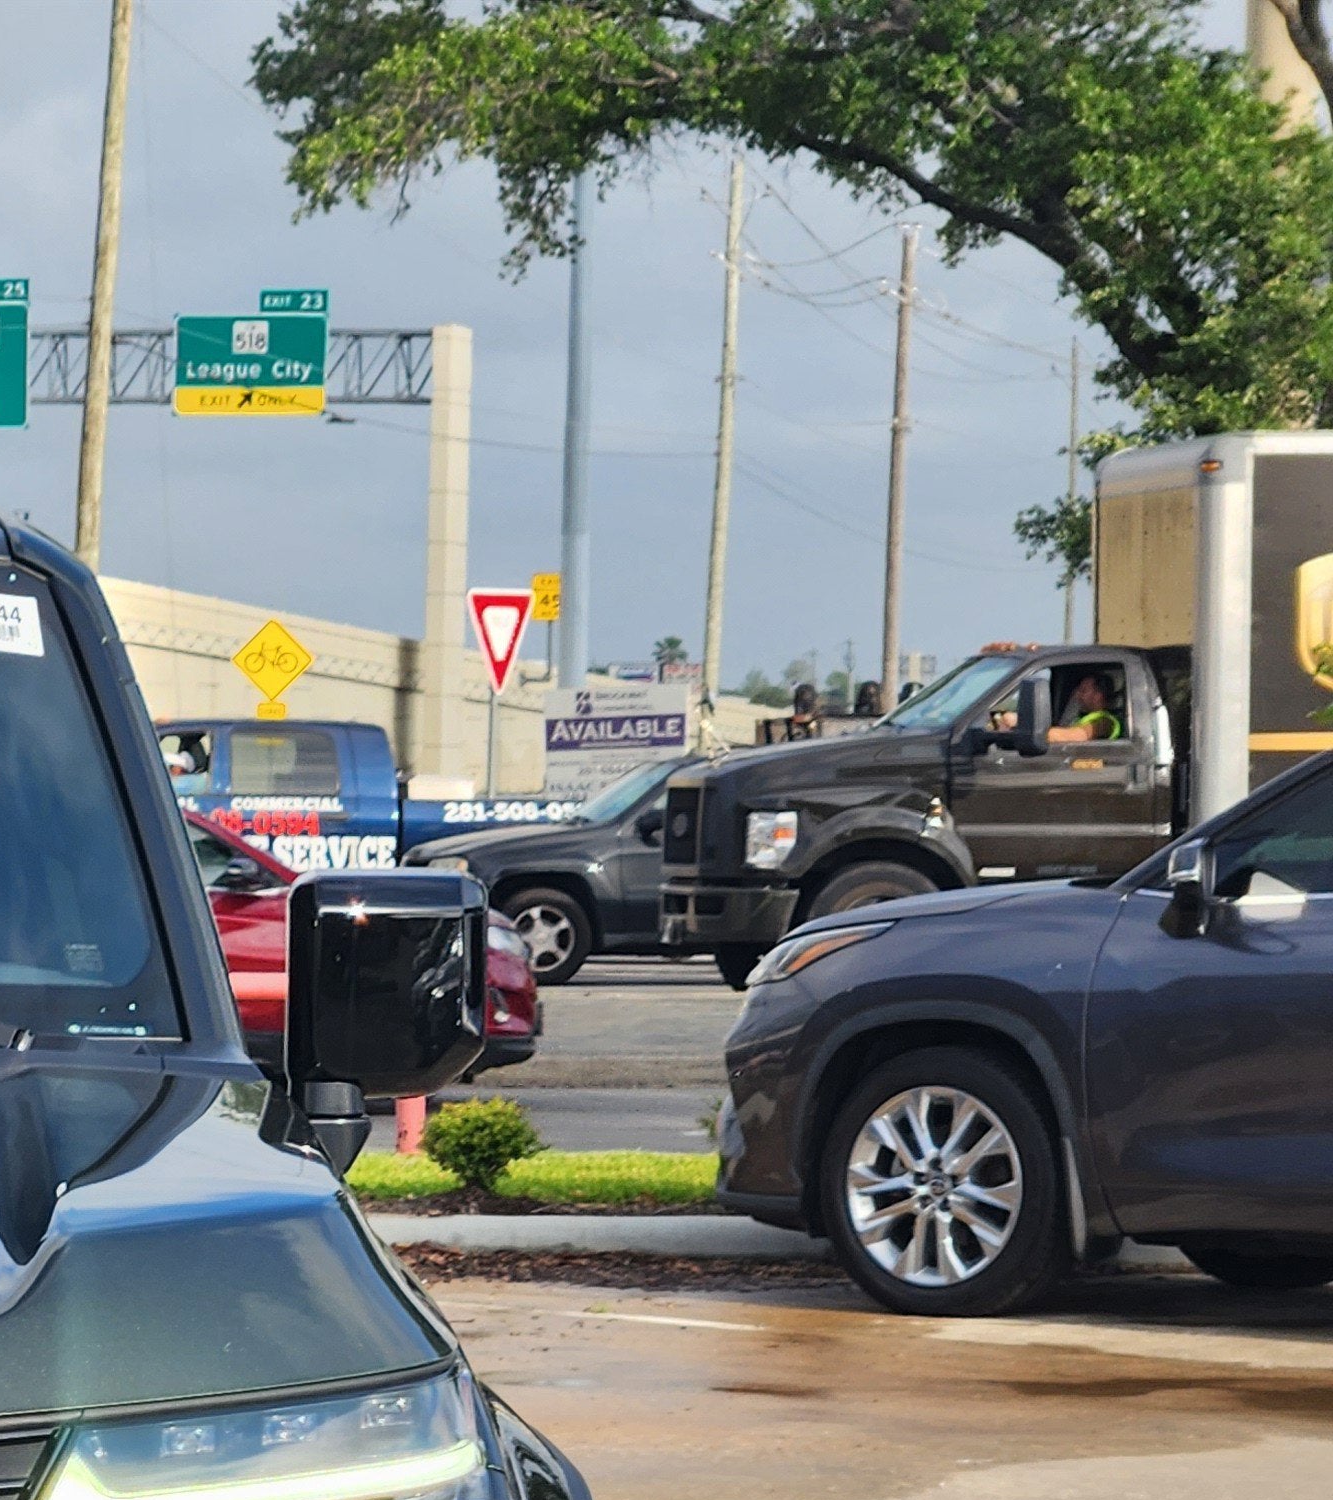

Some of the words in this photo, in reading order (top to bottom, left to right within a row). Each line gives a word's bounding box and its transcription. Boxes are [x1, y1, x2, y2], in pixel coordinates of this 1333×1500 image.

[3, 281, 25, 298] 25
[263, 294, 292, 307] EXIT
[300, 292, 324, 309] 23
[235, 331, 266, 350] 518
[186, 360, 262, 382] League
[271, 359, 314, 383] City
[199, 395, 231, 406] EXIT
[549, 717, 681, 743] AVAILABLE
[230, 796, 344, 812] COMMERCIAL
[272, 835, 397, 872] SERVICE
